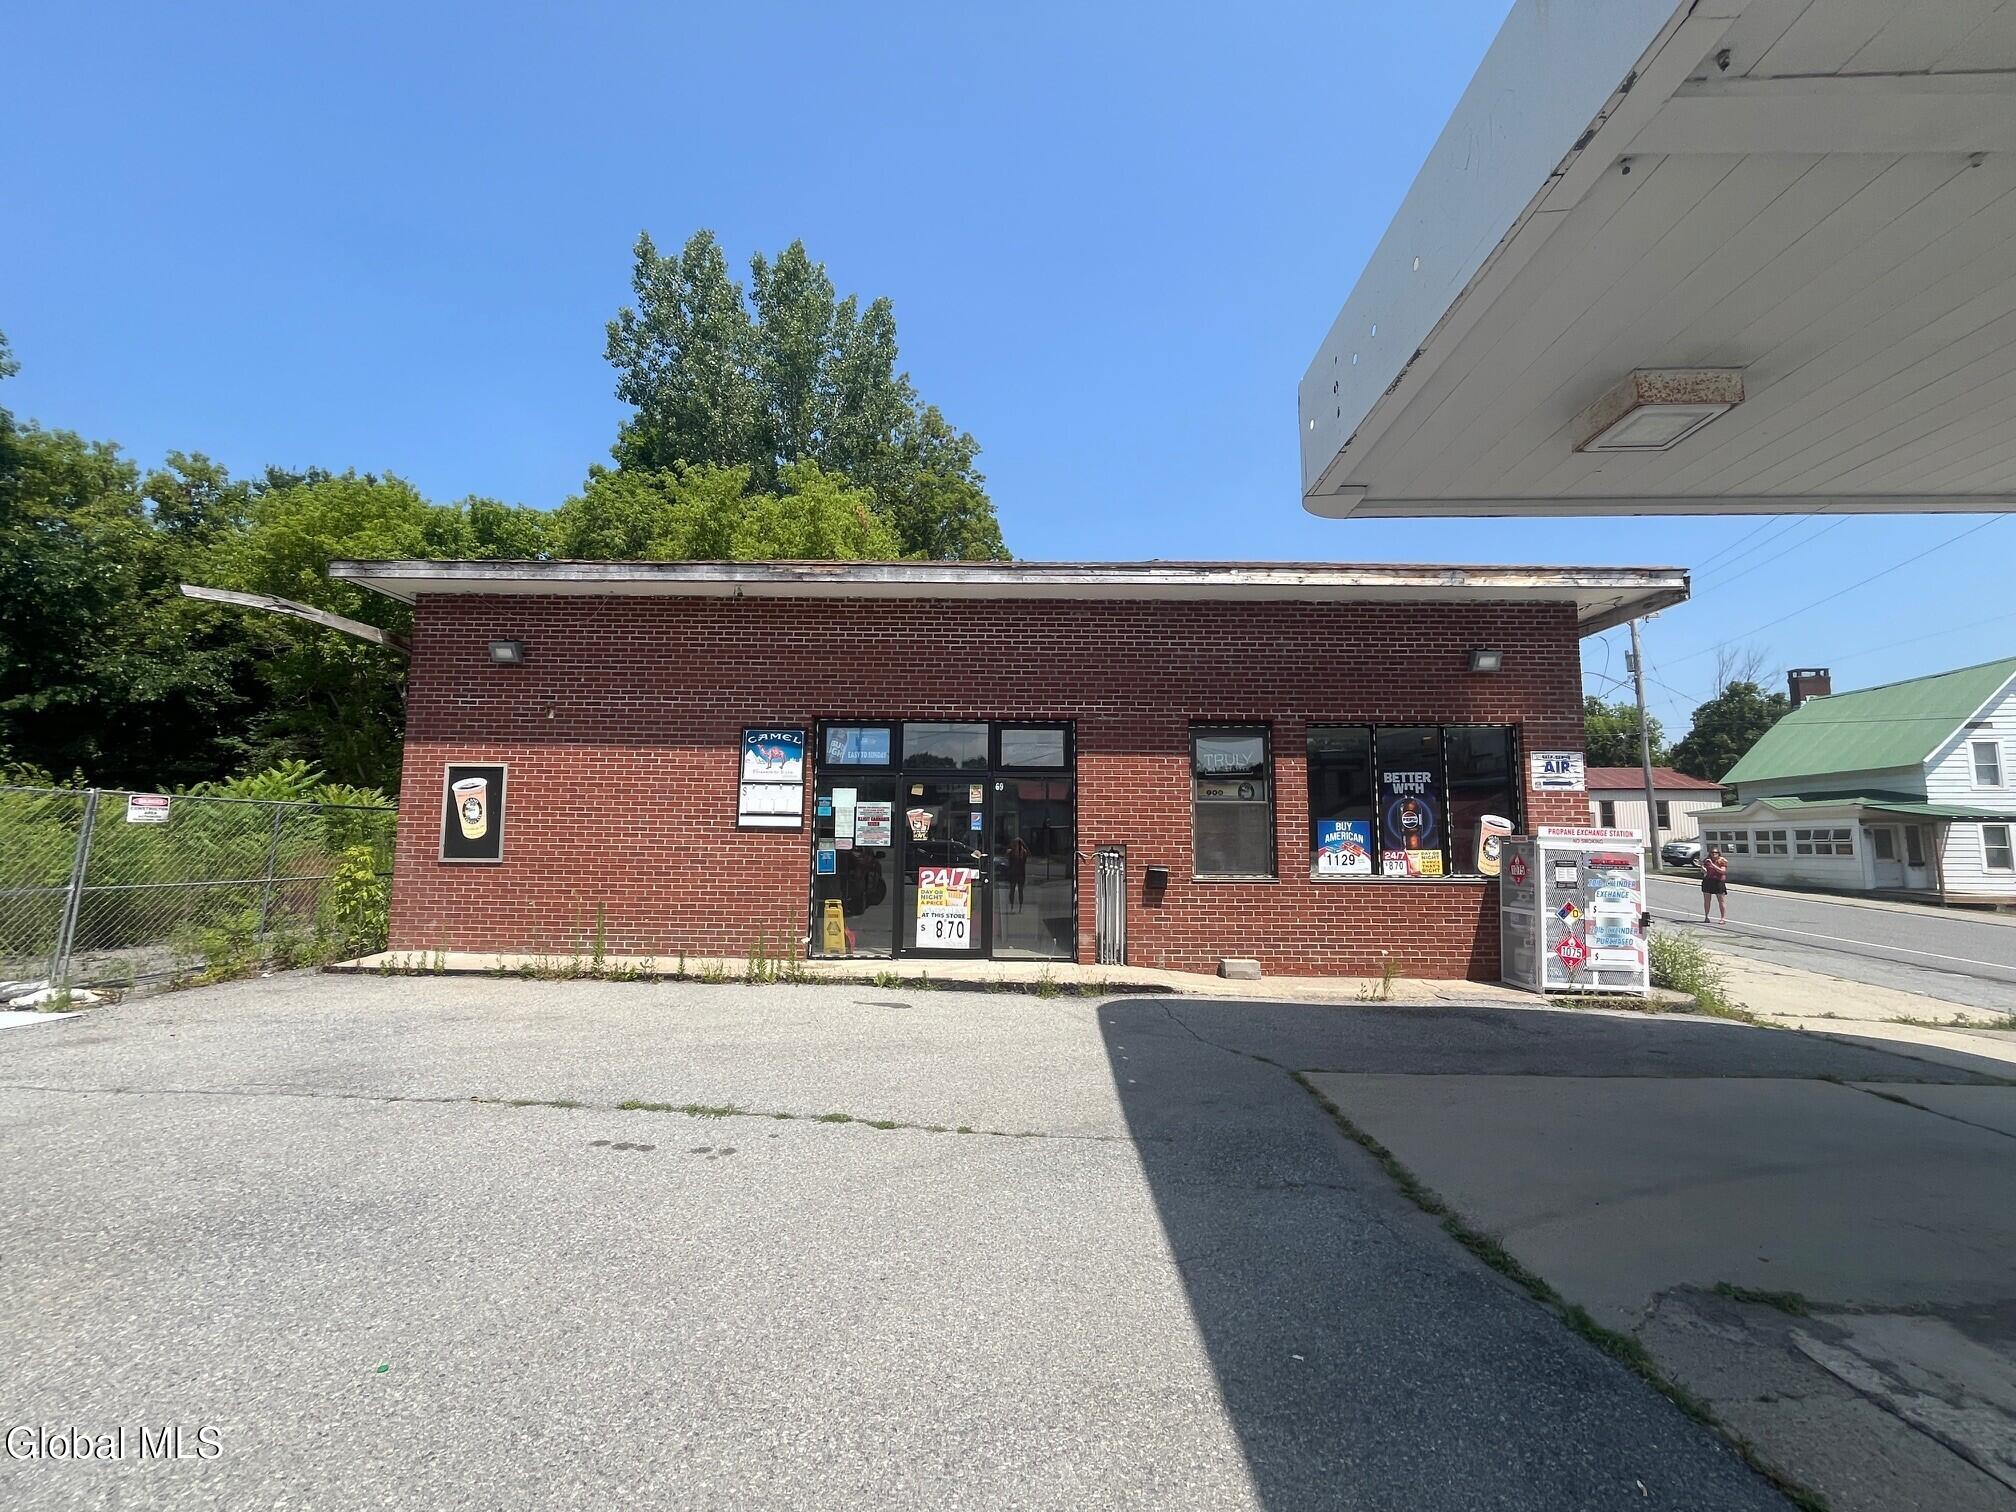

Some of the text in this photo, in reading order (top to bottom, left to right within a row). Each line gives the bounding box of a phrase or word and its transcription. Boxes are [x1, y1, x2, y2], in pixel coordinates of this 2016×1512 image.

[748, 733, 801, 744] CAMEL
[1204, 752, 1253, 767] TRULY
[1544, 760, 1571, 774] AIR
[1384, 772, 1431, 783] BETTER
[995, 782, 1004, 791] 69
[1393, 783, 1424, 794] WITH
[1336, 822, 1352, 831] BUY
[1325, 832, 1364, 844] AMERICAN
[1385, 851, 1405, 860] 24/7
[920, 868, 969, 890] 24/7
[1593, 905, 1597, 913] $
[1562, 947, 1581, 958] 1075
